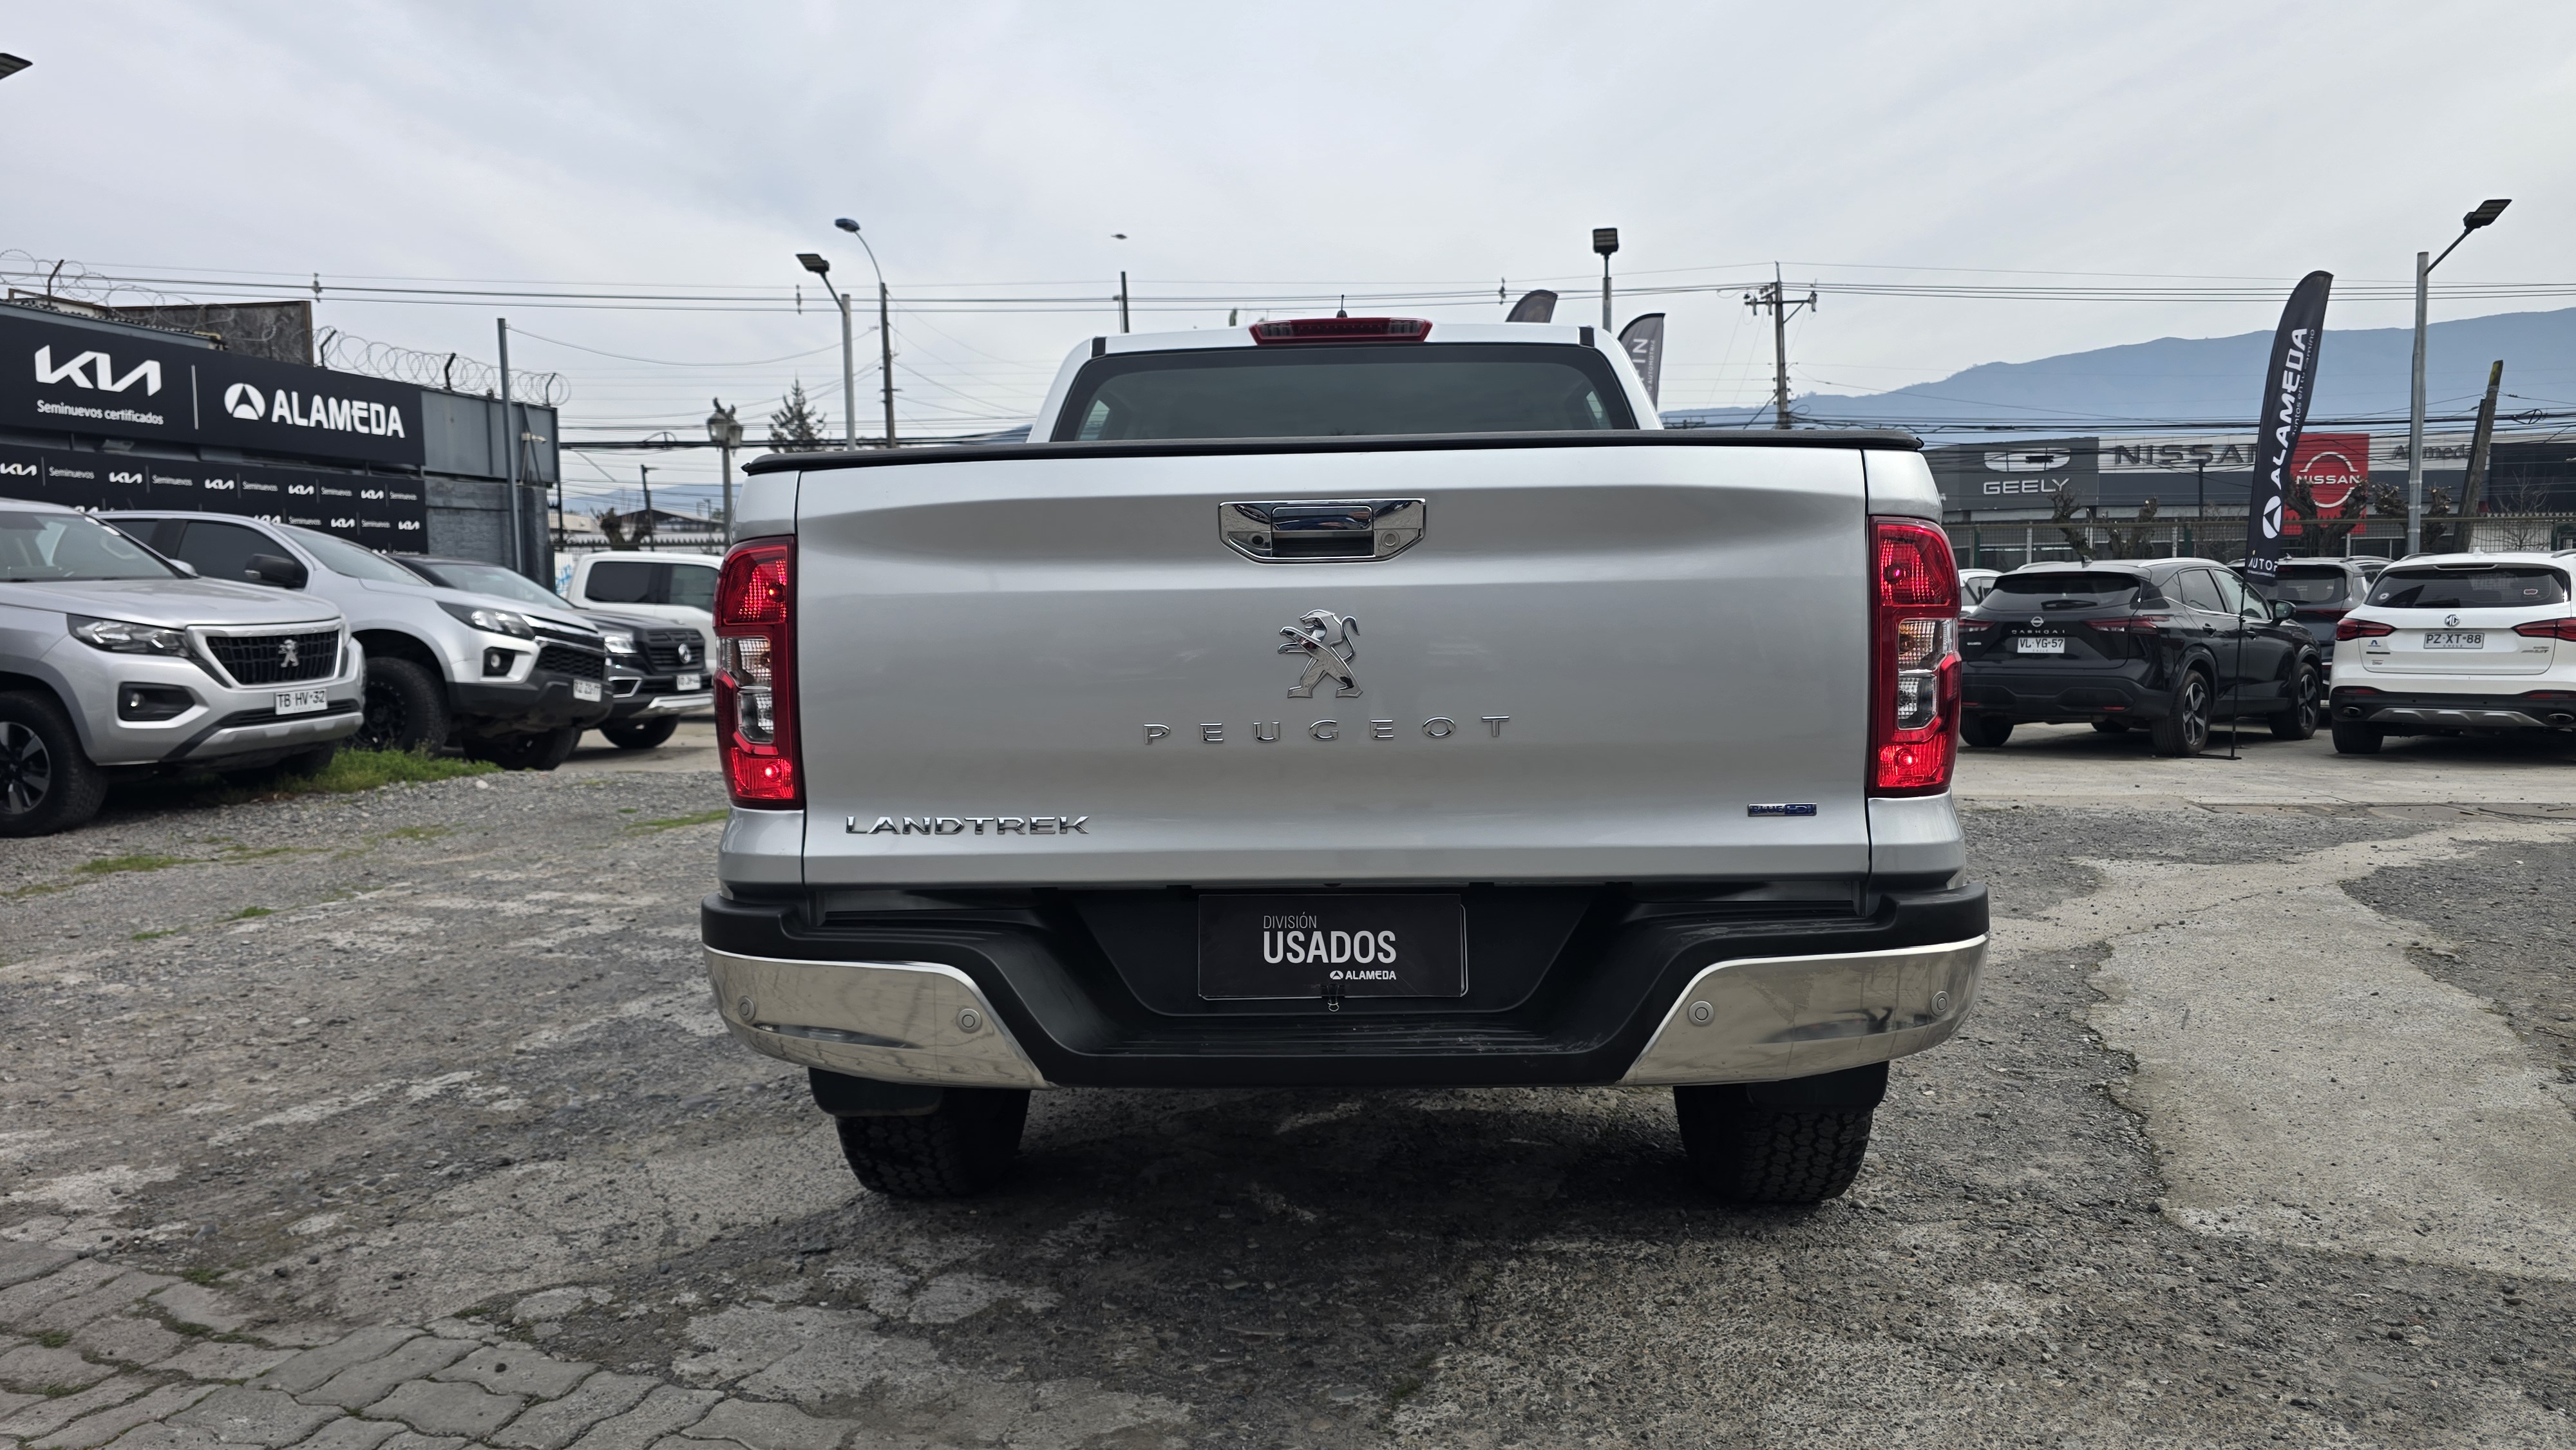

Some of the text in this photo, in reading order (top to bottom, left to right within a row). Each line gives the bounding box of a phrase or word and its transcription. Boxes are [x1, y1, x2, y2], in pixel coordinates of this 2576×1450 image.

[35, 344, 162, 397] KIA
[37, 399, 164, 426] Seminuevos certificados
[271, 389, 406, 438] ALAMEDA
[2271, 328, 2307, 490] ALAMEDA
[0, 462, 37, 476] KIA
[109, 471, 142, 484] KIA
[205, 478, 234, 489] KIA
[2296, 475, 2360, 485] NISSAN
[288, 484, 314, 494] KIA
[1984, 478, 2070, 495] GEELY
[2445, 615, 2459, 626] MG
[1143, 715, 1510, 744] PEUGEOT
[846, 815, 1090, 835] LANDTREK
[1264, 912, 1317, 928] DIVISIÓN
[1264, 930, 1397, 964] USADOS
[1345, 970, 1397, 980] ALAMEDA
